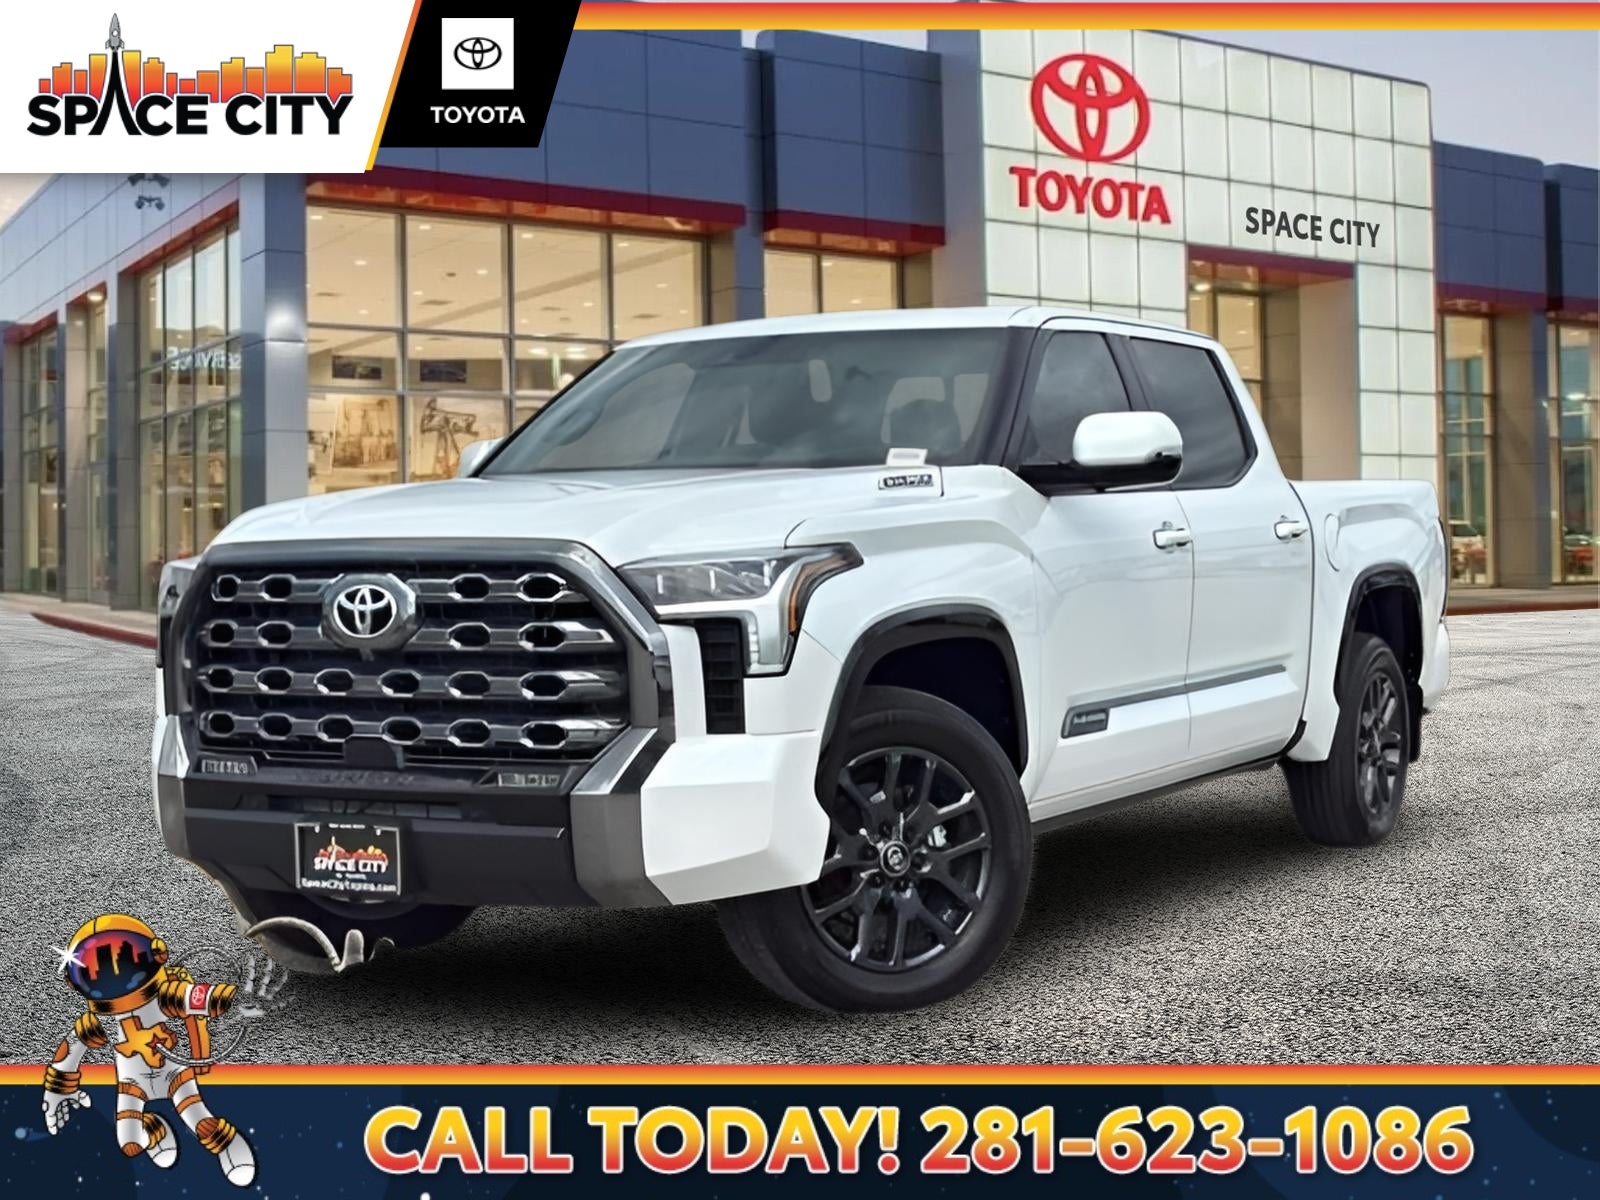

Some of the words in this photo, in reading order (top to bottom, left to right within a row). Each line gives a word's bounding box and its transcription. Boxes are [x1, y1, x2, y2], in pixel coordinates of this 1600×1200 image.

[1009, 166, 1171, 225] TOYOTA
[1245, 207, 1323, 242] SPACE
[1329, 218, 1380, 248] CITY
